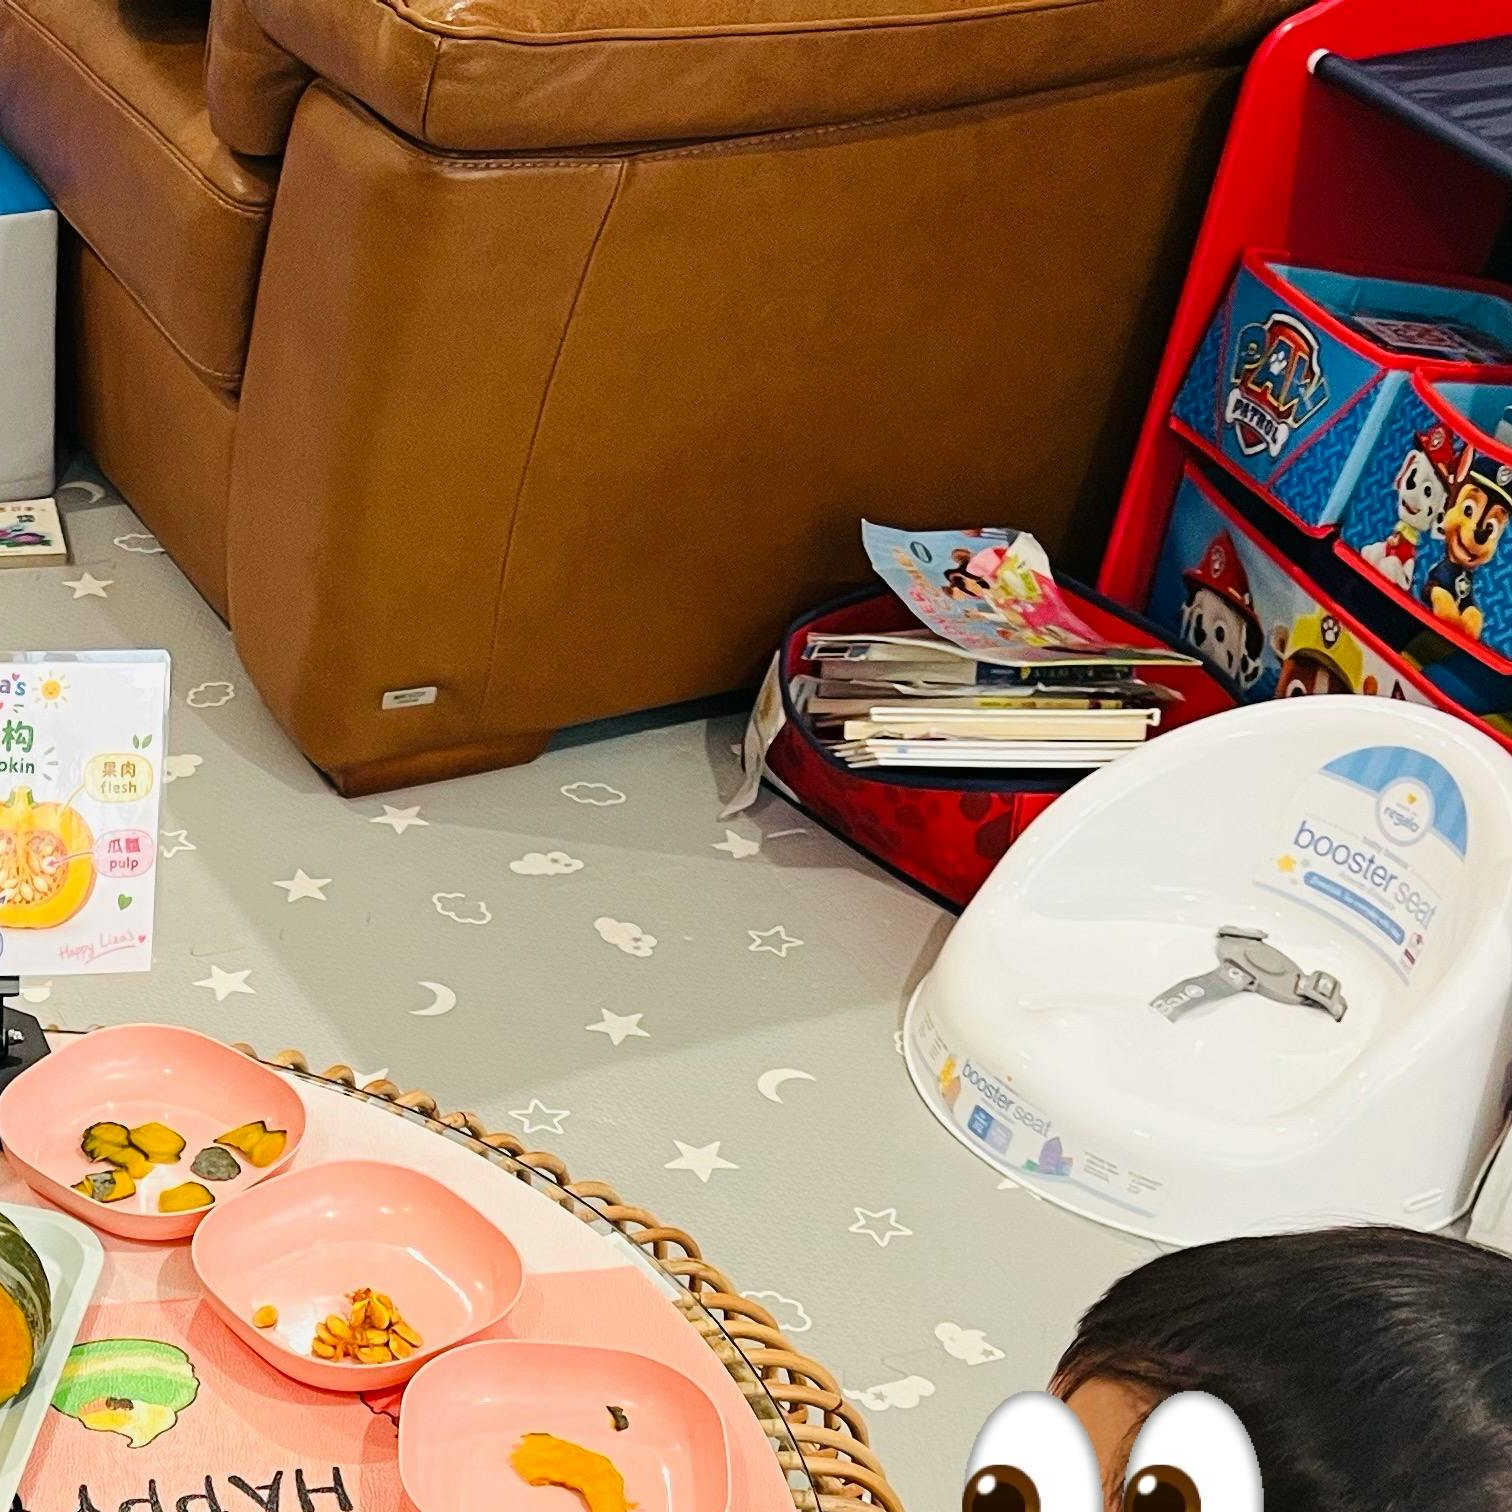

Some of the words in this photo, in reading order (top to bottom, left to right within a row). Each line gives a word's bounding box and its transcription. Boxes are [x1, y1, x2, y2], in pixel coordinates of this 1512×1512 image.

[1232, 398, 1278, 444] PATROL
[102, 760, 136, 778] 果肉
[100, 780, 137, 794] flesh
[109, 856, 139, 872] pulp
[1293, 819, 1399, 893] booster
[1394, 881, 1438, 930] seat
[58, 943, 95, 962] Happy
[962, 1058, 1015, 1112] booster
[1013, 1104, 1053, 1138] seat
